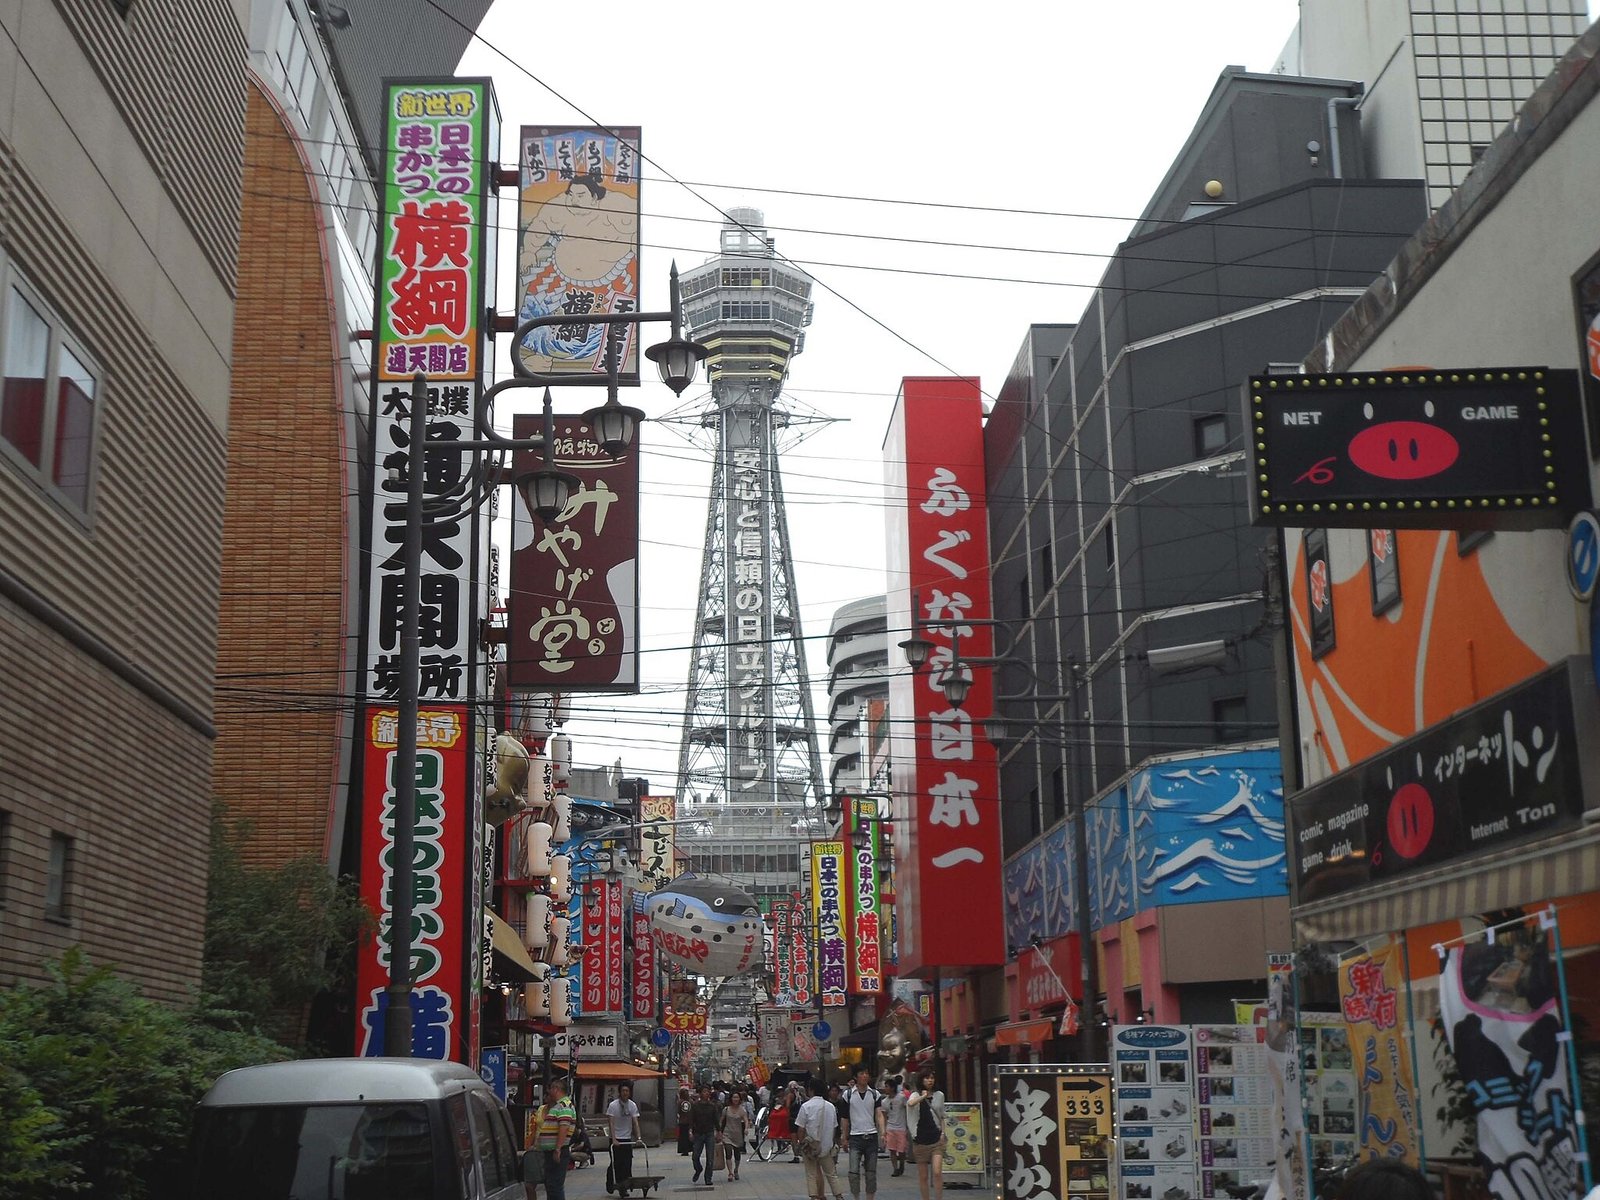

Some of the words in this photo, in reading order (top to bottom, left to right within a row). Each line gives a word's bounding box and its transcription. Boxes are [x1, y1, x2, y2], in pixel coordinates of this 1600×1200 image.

[398, 91, 475, 117] 新世界
[395, 124, 432, 195] 串かつ
[436, 123, 472, 194] 日本一の
[528, 142, 545, 182] 串かつ
[391, 202, 471, 336] 横綱
[386, 344, 468, 374] 通天閣店
[1283, 411, 1322, 425] NET
[1461, 405, 1519, 420] GAME
[378, 422, 465, 651] 通天閣
[528, 480, 619, 674] みやげ堂
[1300, 820, 1324, 842] comic
[1328, 802, 1369, 831] magazine
[1471, 816, 1509, 841] Internet
[1516, 802, 1556, 824] Ton
[1302, 851, 1324, 873] game
[1330, 840, 1353, 862] drink
[820, 856, 840, 936] 日本一の串かつ
[820, 937, 847, 992] 横綱
[856, 912, 880, 975] 横綱
[665, 1013, 705, 1030] くすり
[1004, 1078, 1058, 1200] 串か
